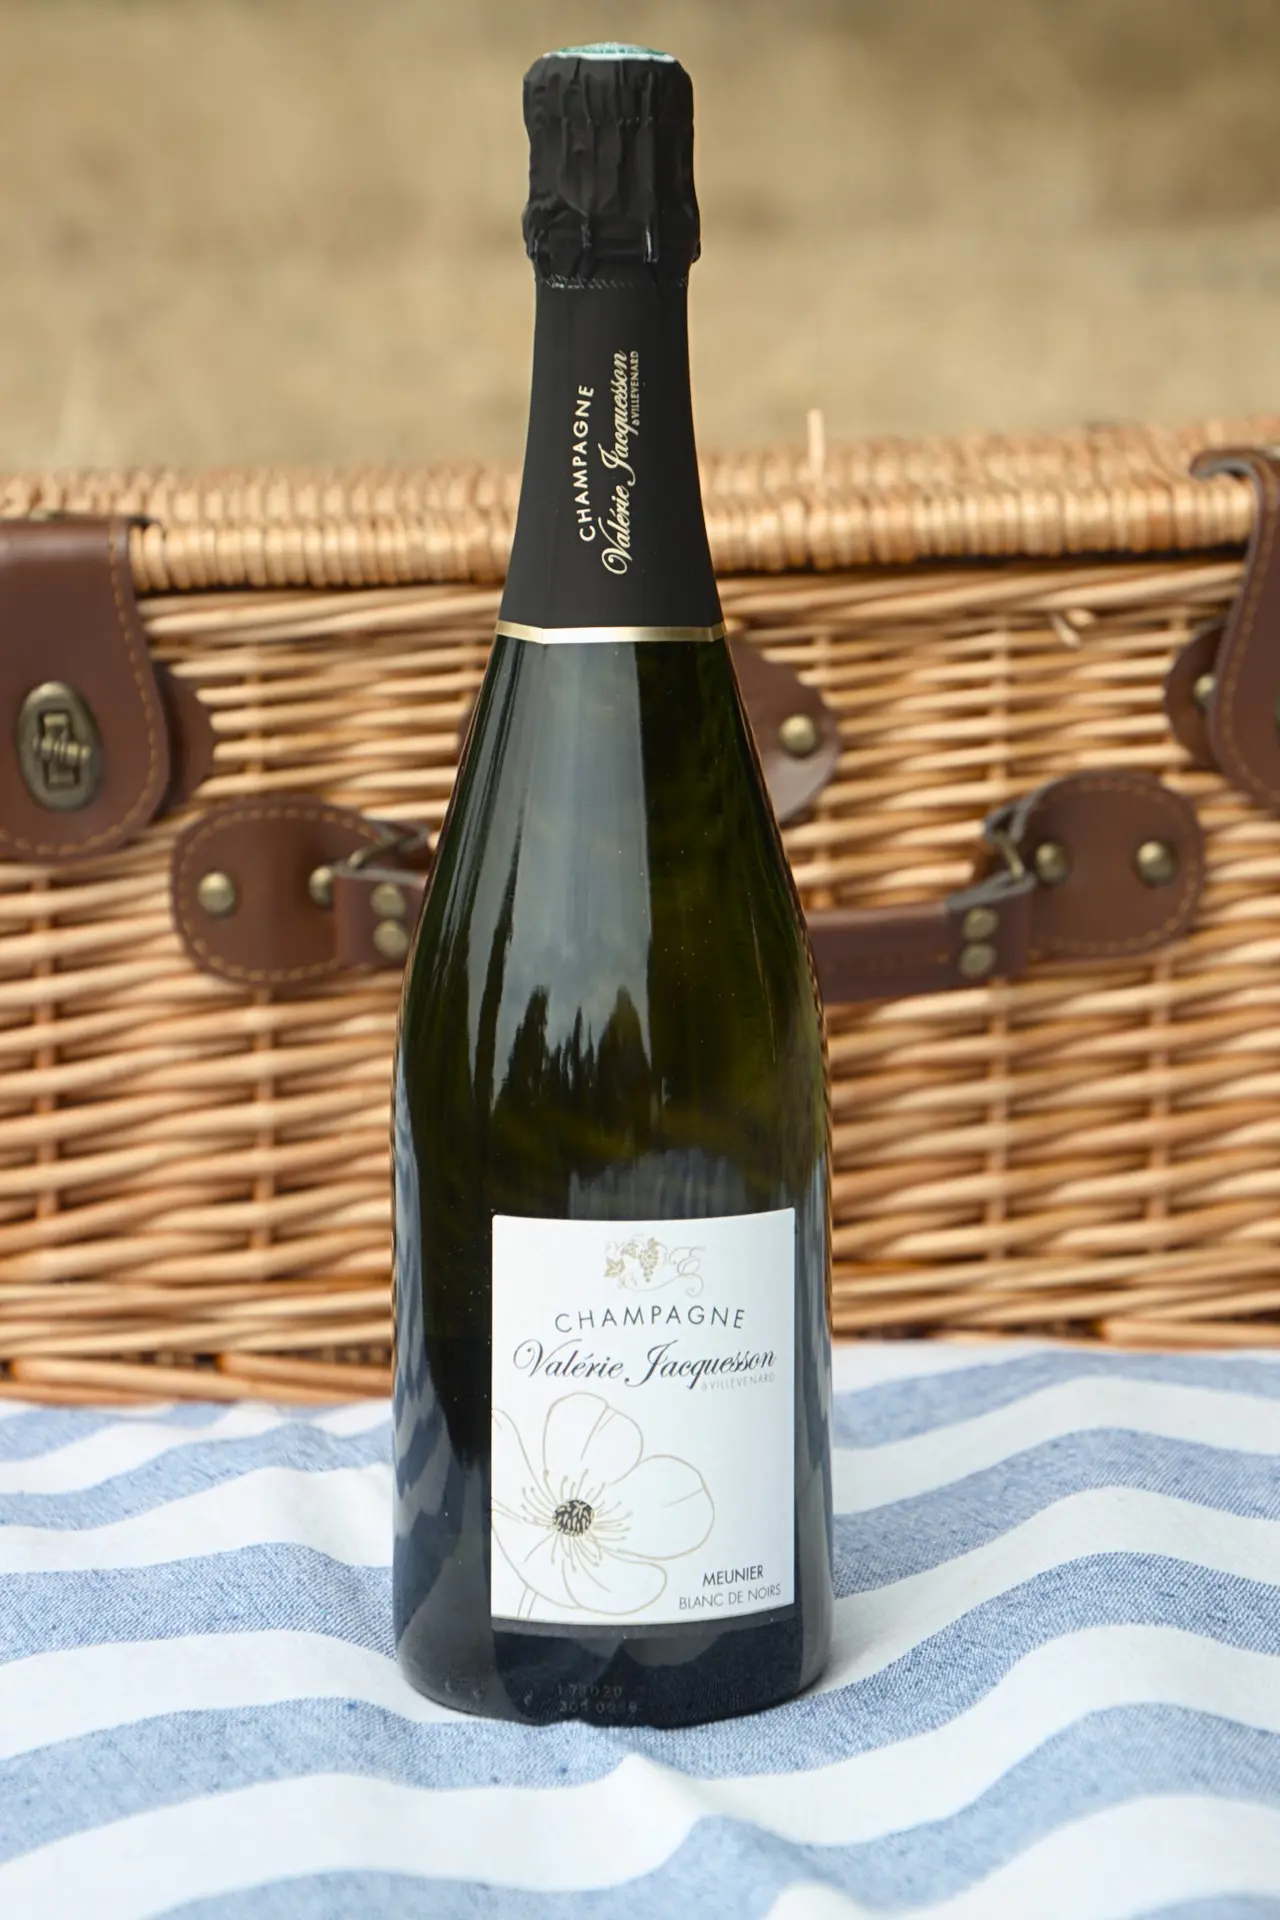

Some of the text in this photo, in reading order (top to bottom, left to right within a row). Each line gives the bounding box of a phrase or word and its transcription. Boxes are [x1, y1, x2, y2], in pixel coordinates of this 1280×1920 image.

[630, 350, 640, 419] VILLEVENARD
[572, 385, 596, 542] CHAMPAGNE
[598, 350, 639, 575] Valérie Jacquesson
[555, 1305, 746, 1333] CHAMPAGNE
[513, 1339, 778, 1390] Valérie Jacquesson
[709, 1371, 775, 1391] VILLEVENARD
[702, 1564, 764, 1587] MEUNIER
[679, 1583, 782, 1611] BLANC DE NOIRS
